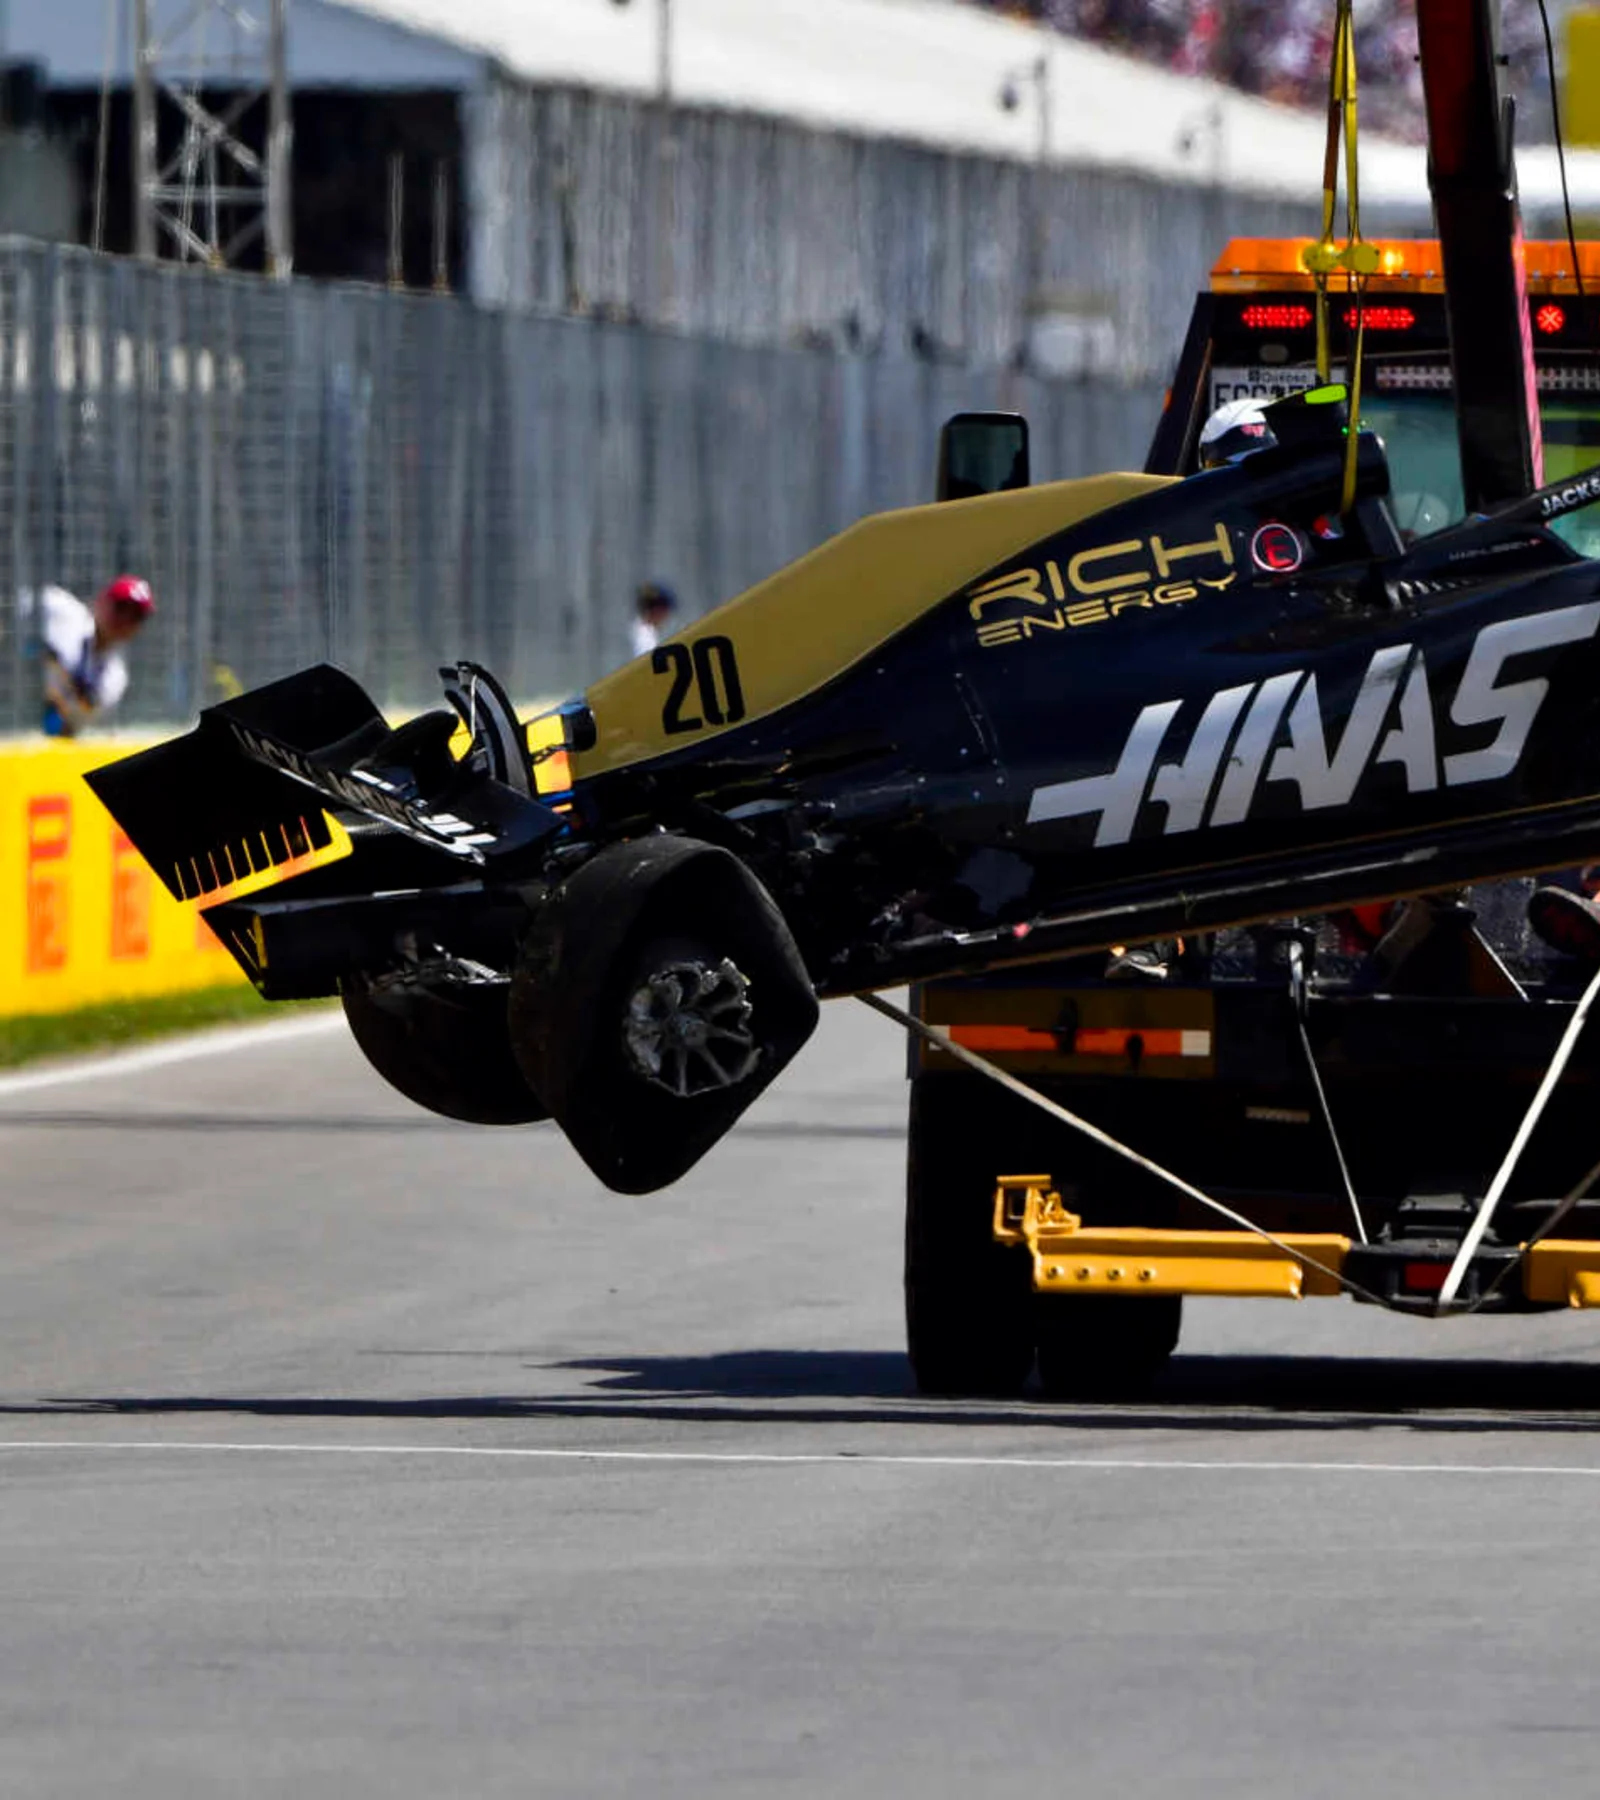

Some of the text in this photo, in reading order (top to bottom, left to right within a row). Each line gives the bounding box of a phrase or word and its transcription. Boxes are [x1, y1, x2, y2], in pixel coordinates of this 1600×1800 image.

[968, 521, 1235, 621] RICH
[975, 571, 1238, 648] ENERGY
[651, 635, 746, 735] 20
